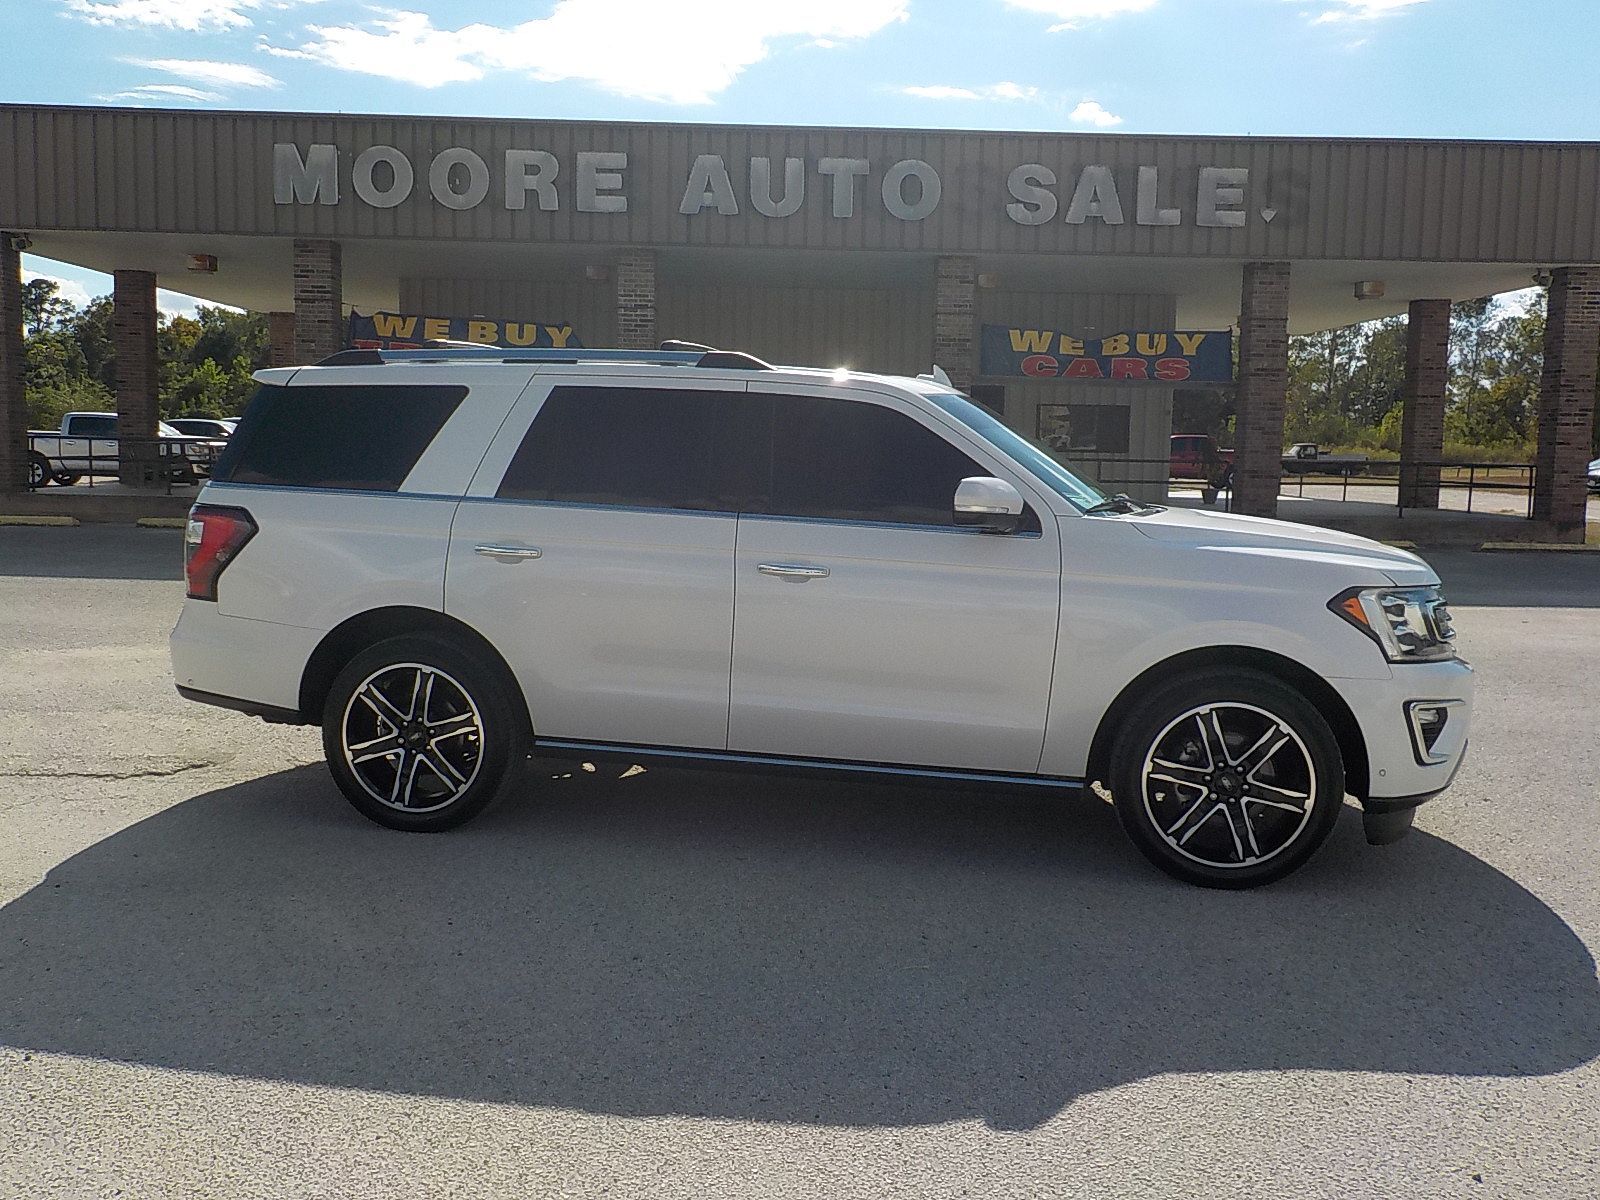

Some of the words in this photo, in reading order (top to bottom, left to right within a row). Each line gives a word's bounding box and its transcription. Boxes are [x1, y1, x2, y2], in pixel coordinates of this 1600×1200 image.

[272, 142, 628, 213] MOORE
[678, 154, 942, 221] AUTO
[372, 313, 451, 340] WE
[467, 320, 573, 348] BUY
[1008, 329, 1085, 356] WE
[1101, 332, 1207, 356] BUY
[1020, 354, 1191, 381] CARS
